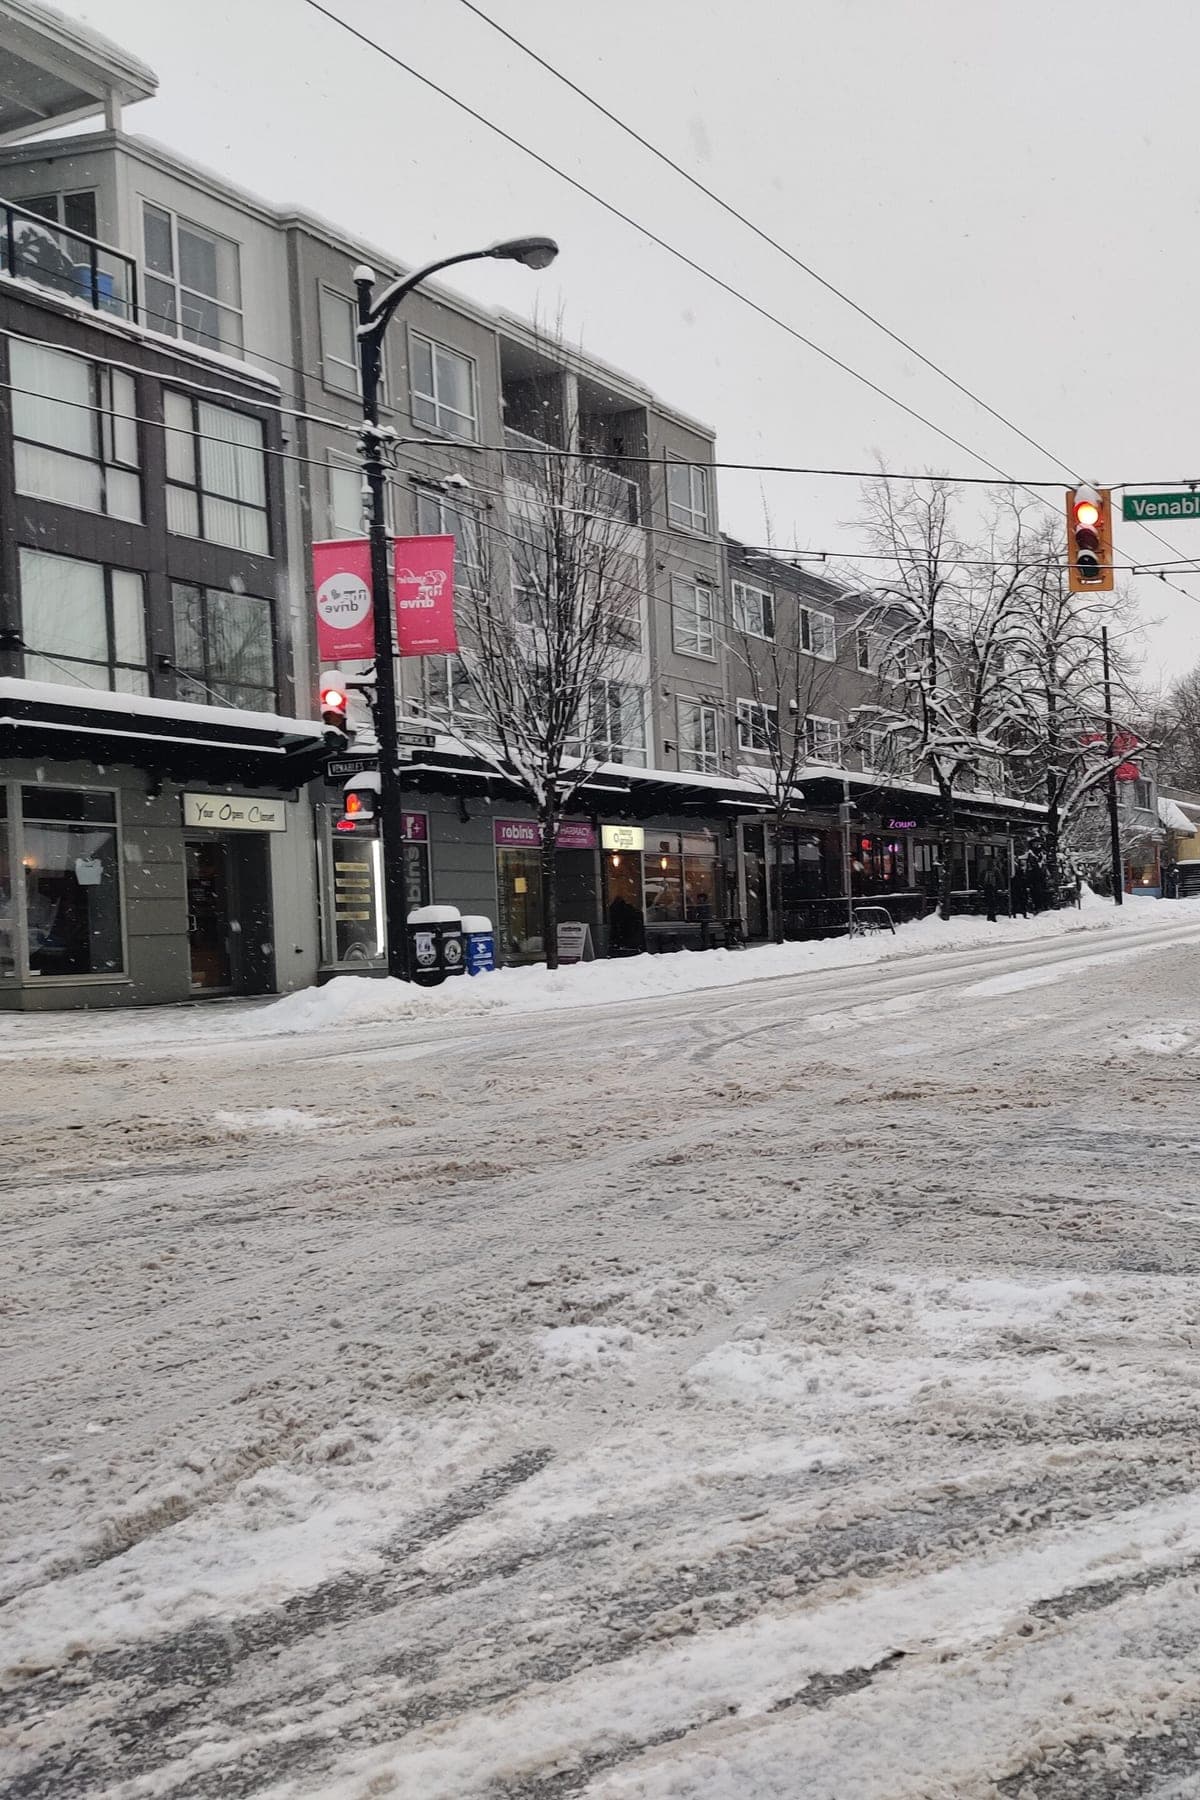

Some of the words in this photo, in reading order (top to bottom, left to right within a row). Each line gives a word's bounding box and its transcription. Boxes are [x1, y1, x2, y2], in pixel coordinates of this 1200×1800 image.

[196, 802, 214, 821] Your
[219, 803, 244, 822] Open
[248, 806, 275, 823] Closet
[502, 825, 534, 840] robin's
